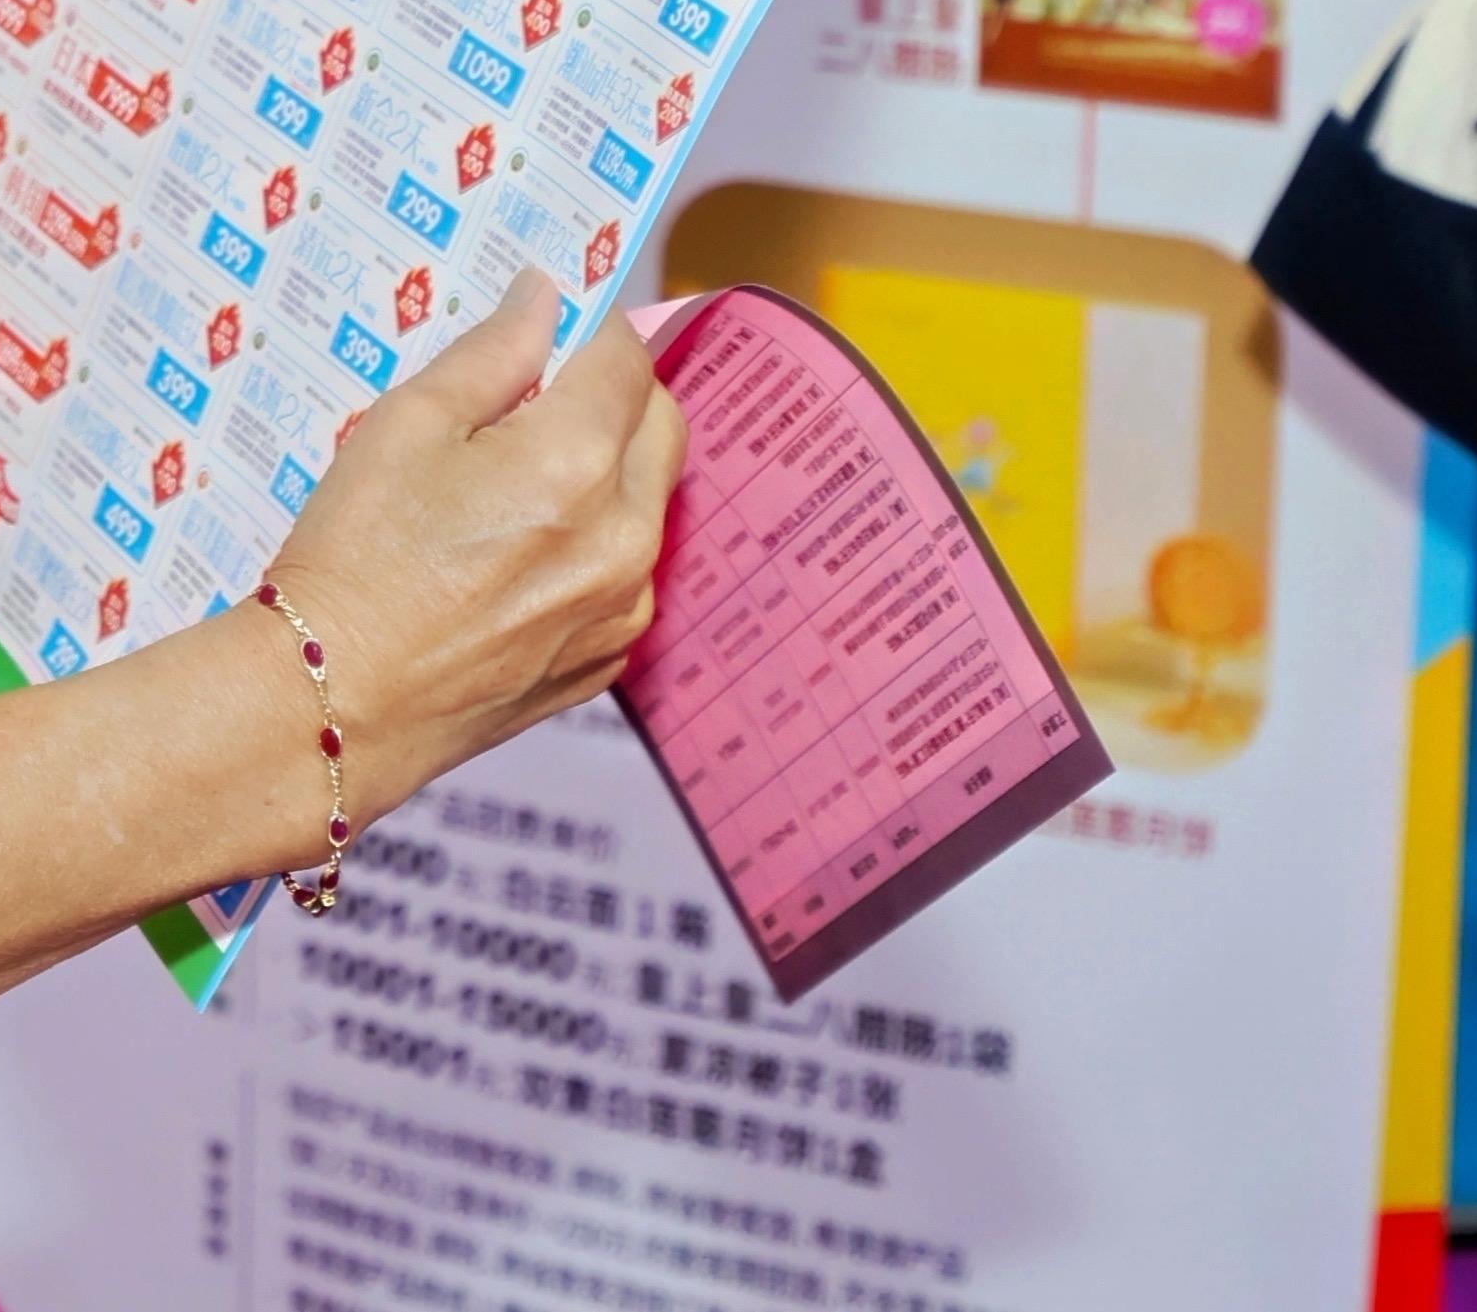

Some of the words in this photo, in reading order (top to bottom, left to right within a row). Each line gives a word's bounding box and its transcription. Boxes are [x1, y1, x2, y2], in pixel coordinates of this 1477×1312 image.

[523, 9, 552, 37] 400
[452, 41, 515, 99] 1099
[262, 89, 312, 140] 299
[657, 102, 684, 128] 200
[393, 184, 445, 237] 299
[206, 223, 257, 276] 399
[584, 249, 612, 278] 100
[336, 326, 386, 380] 399
[152, 360, 201, 413] 399
